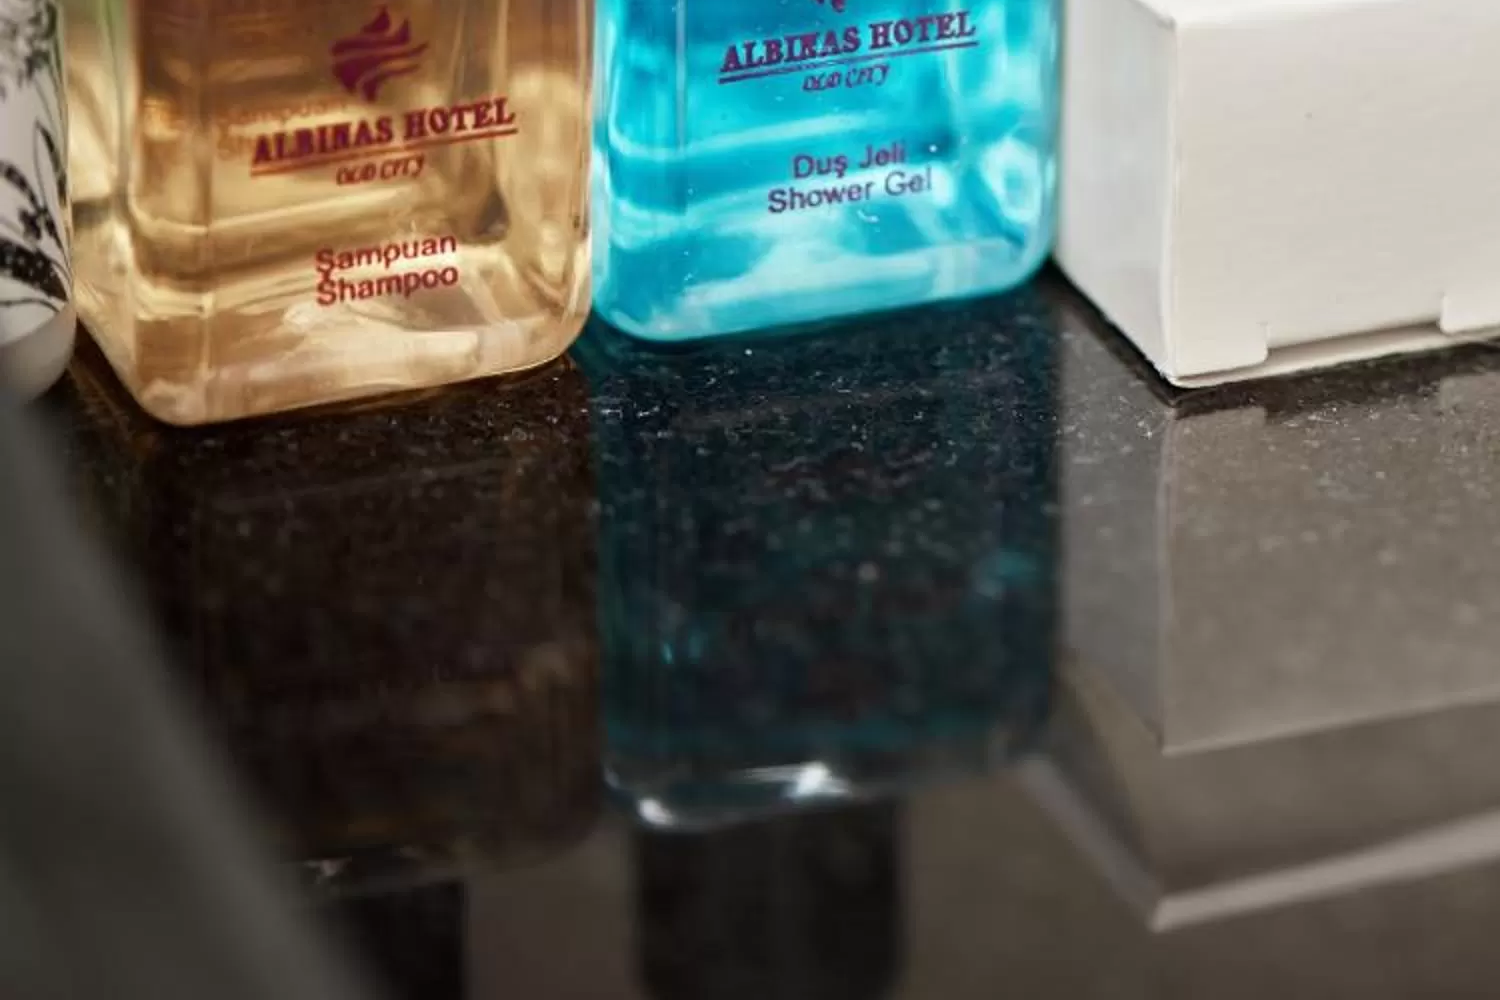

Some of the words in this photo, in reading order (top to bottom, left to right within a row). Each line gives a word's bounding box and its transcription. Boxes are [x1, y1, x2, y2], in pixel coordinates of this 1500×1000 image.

[869, 11, 977, 49] HOTEL
[403, 97, 516, 140] HOTEL
[792, 153, 849, 179] Duş
[859, 142, 907, 169] Jeli
[767, 180, 875, 214] Shower
[884, 164, 932, 196] Gel
[316, 266, 458, 306] Shampoo
